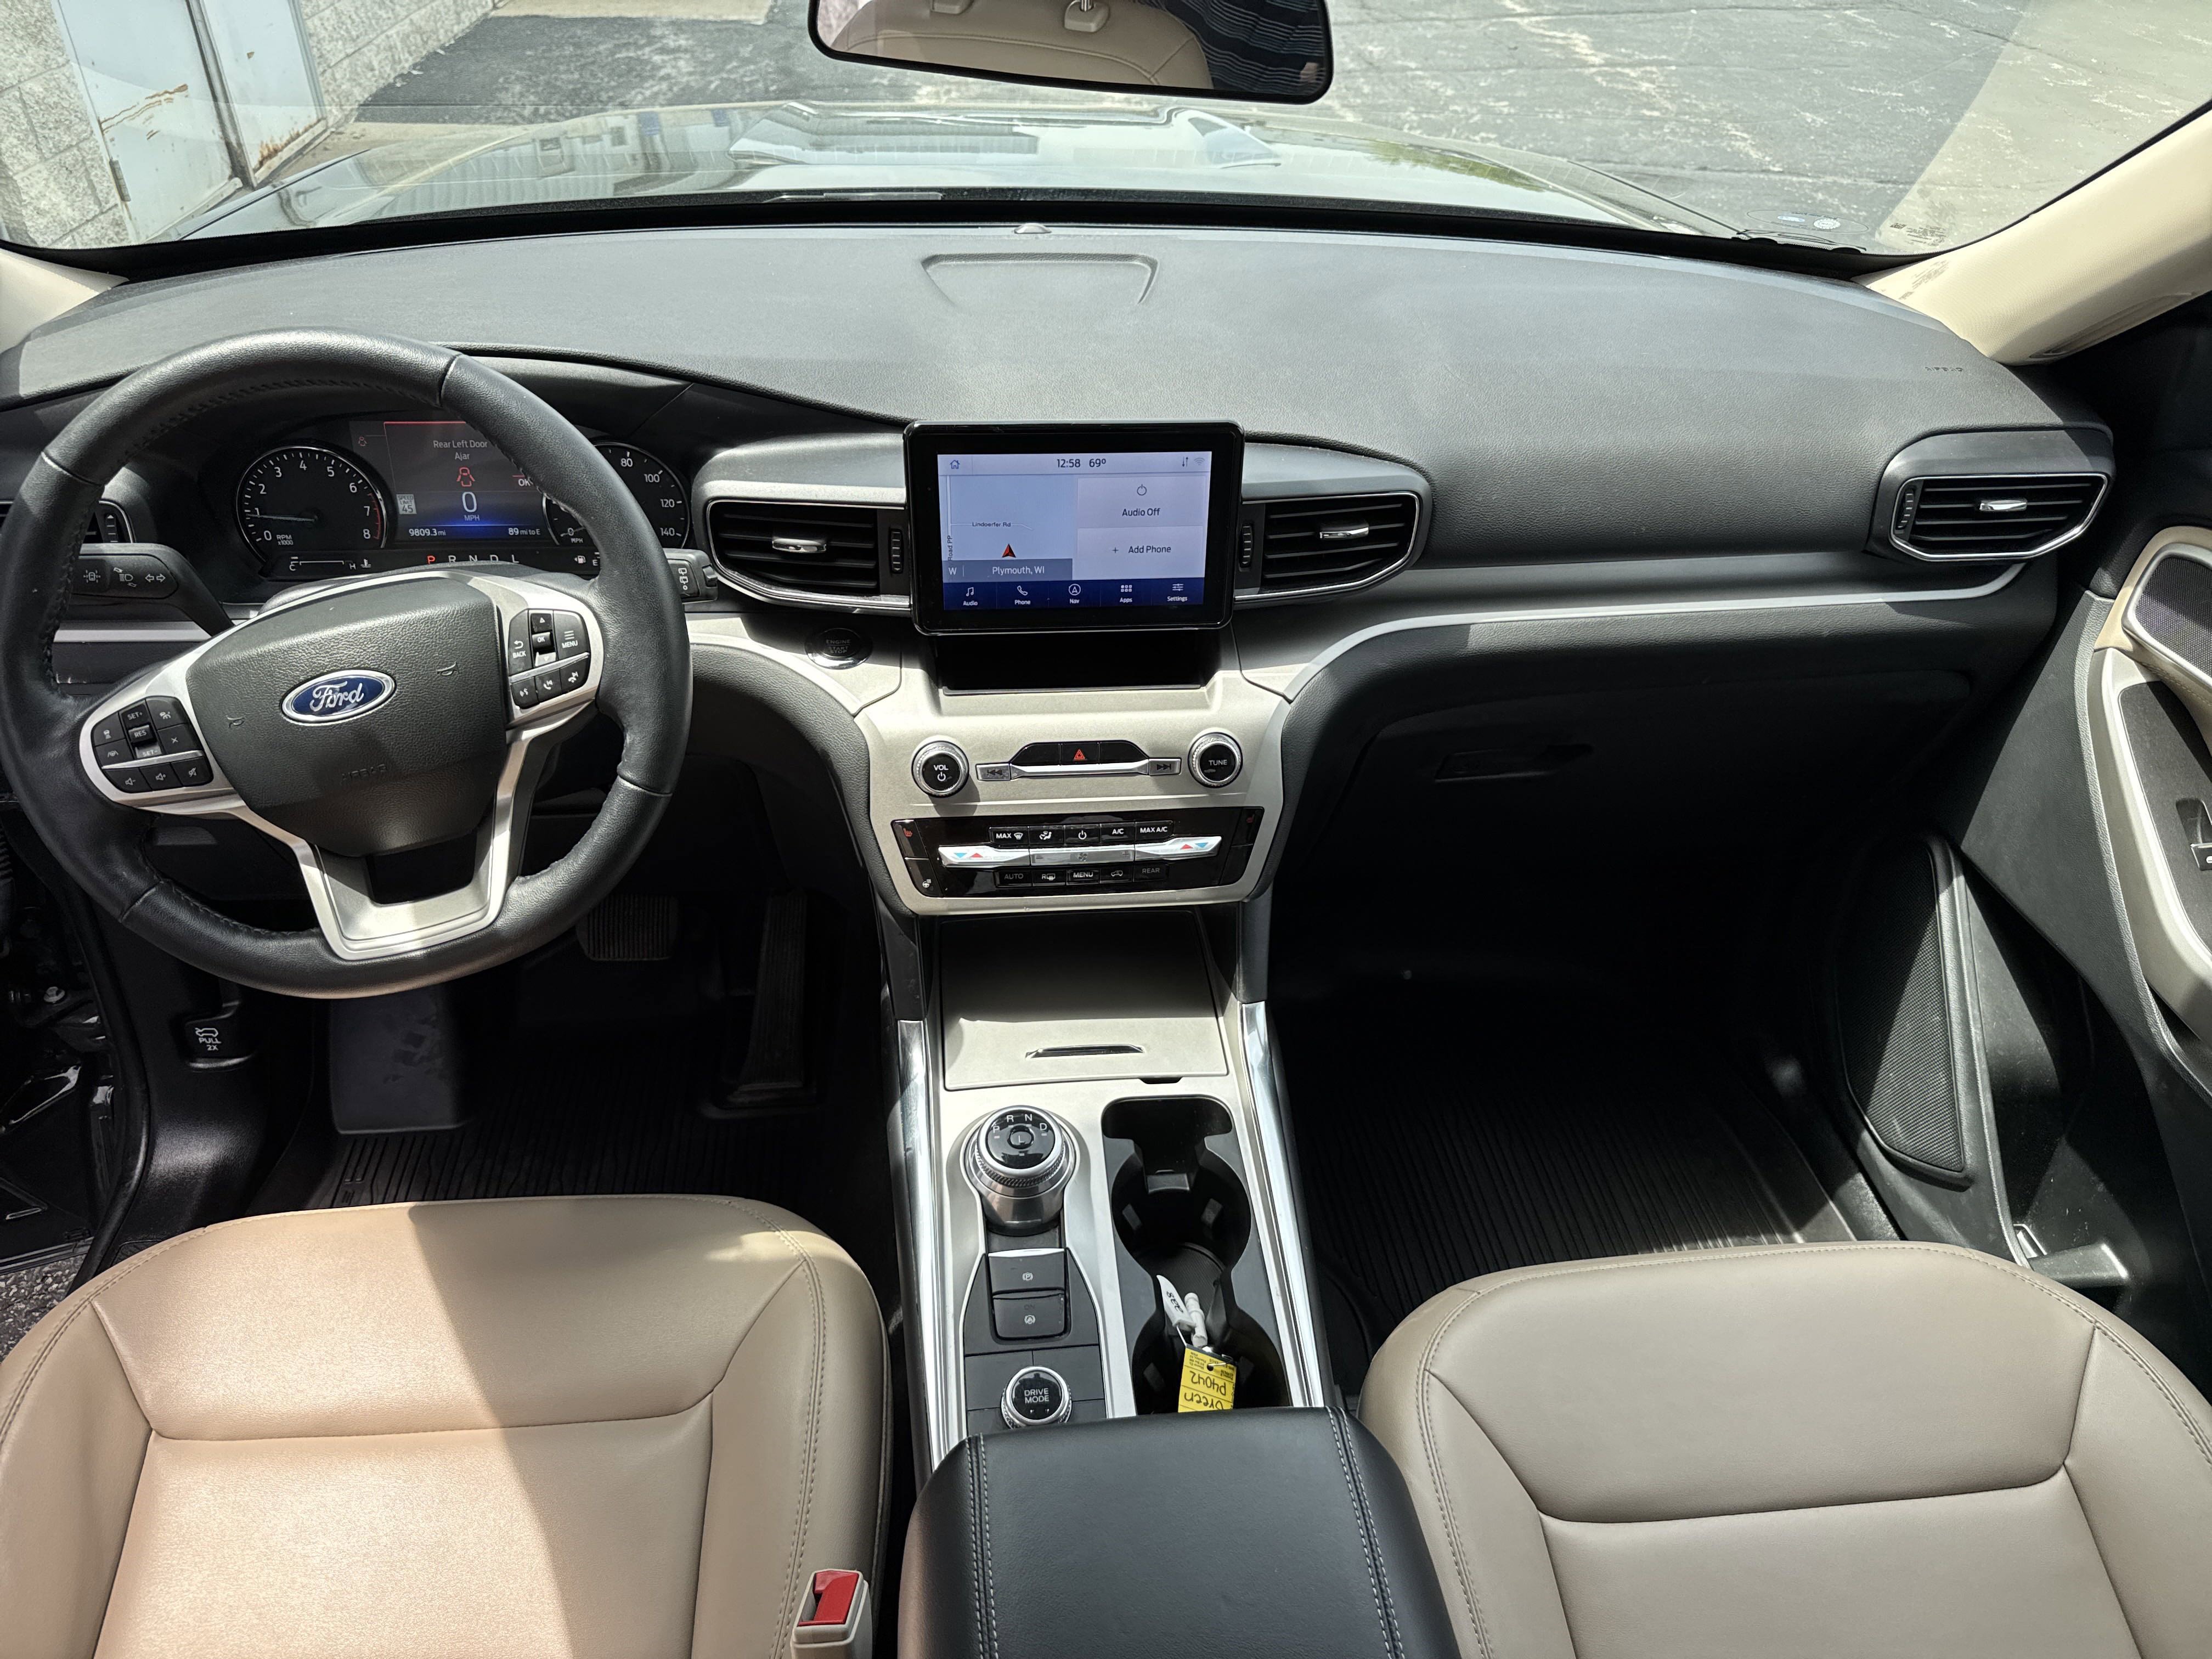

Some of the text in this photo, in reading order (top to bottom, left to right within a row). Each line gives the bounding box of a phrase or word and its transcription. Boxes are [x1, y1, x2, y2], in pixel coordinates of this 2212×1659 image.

[453, 440, 469, 448] Left
[455, 452, 470, 461] Ajar
[299, 460, 307, 471] 4
[621, 458, 633, 467] 80
[1057, 459, 1081, 467] 12:58
[274, 467, 282, 478] 3
[327, 466, 335, 477] 5
[644, 473, 660, 483] 100
[258, 484, 267, 494] 2
[349, 483, 357, 493] 6
[462, 492, 477, 512] 0
[661, 499, 675, 508] 120
[255, 507, 260, 517] 1
[364, 506, 370, 516] 7
[402, 505, 414, 514] 45
[264, 531, 272, 541] 0
[363, 529, 371, 539] 8
[409, 528, 437, 537] 9809.3
[567, 527, 574, 536] 0
[661, 528, 675, 537] 140
[947, 535, 953, 544] PP
[427, 555, 436, 565] P
[512, 554, 520, 563] L
[949, 567, 957, 575] W
[992, 566, 1045, 575] Plymouth, WI
[562, 640, 578, 648] MENU
[512, 651, 527, 659] BACK
[309, 680, 364, 712] Ford
[134, 730, 147, 738] RES
[1006, 1114, 1014, 1122] R
[1024, 1114, 1033, 1122] N
[992, 1125, 1001, 1133] P
[1018, 1135, 1025, 1143] L
[1024, 1387, 1049, 1396] DRIVE
[1024, 1395, 1049, 1404] MODE
